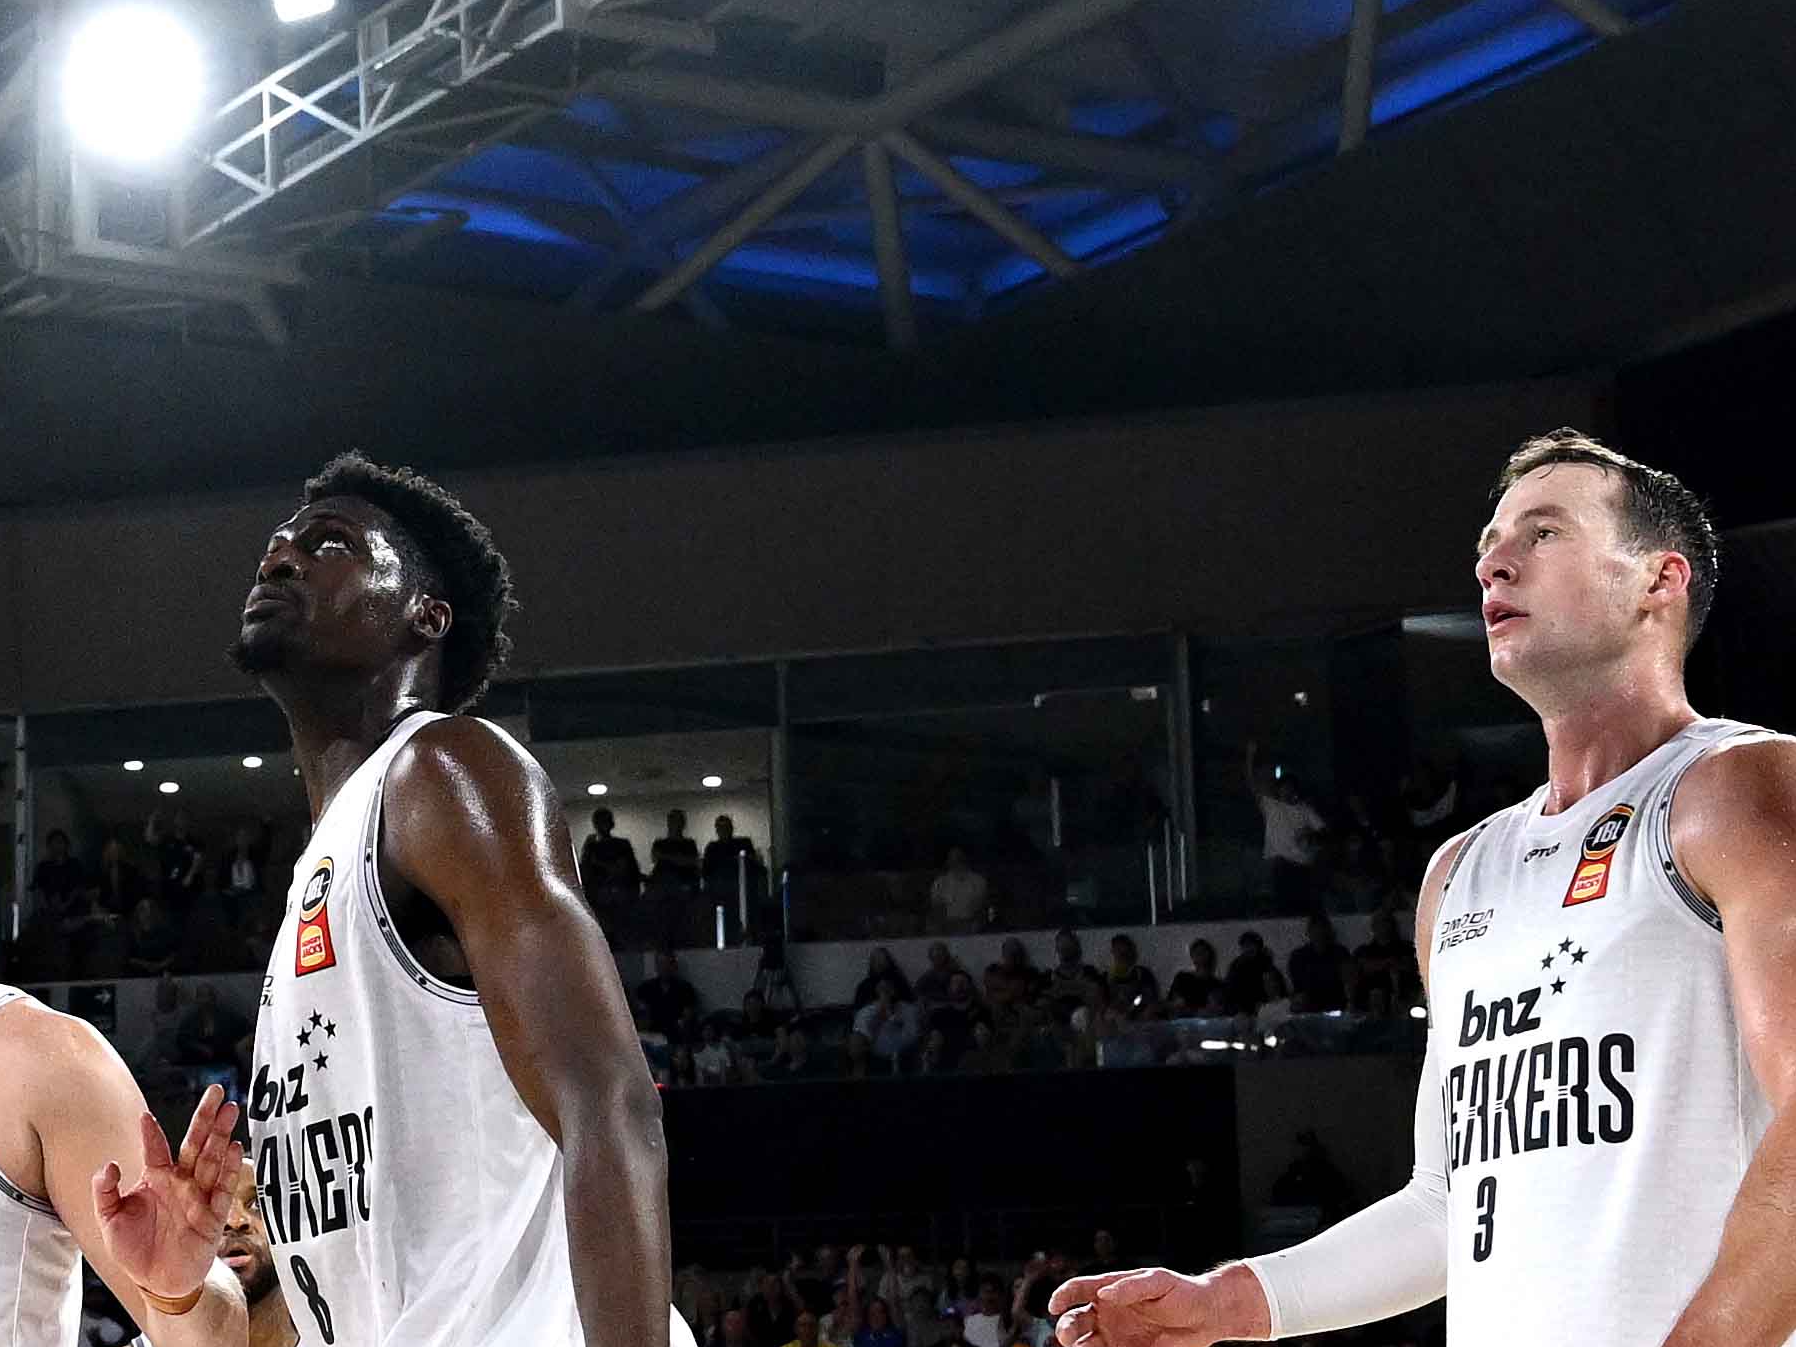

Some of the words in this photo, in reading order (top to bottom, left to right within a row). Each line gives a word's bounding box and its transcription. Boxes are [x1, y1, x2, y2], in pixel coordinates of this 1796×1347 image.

[1459, 985, 1543, 1047] bnz
[1442, 1033, 1635, 1193] EAKERS
[1473, 1176, 1497, 1262] 3
[290, 1254, 335, 1346] 8
